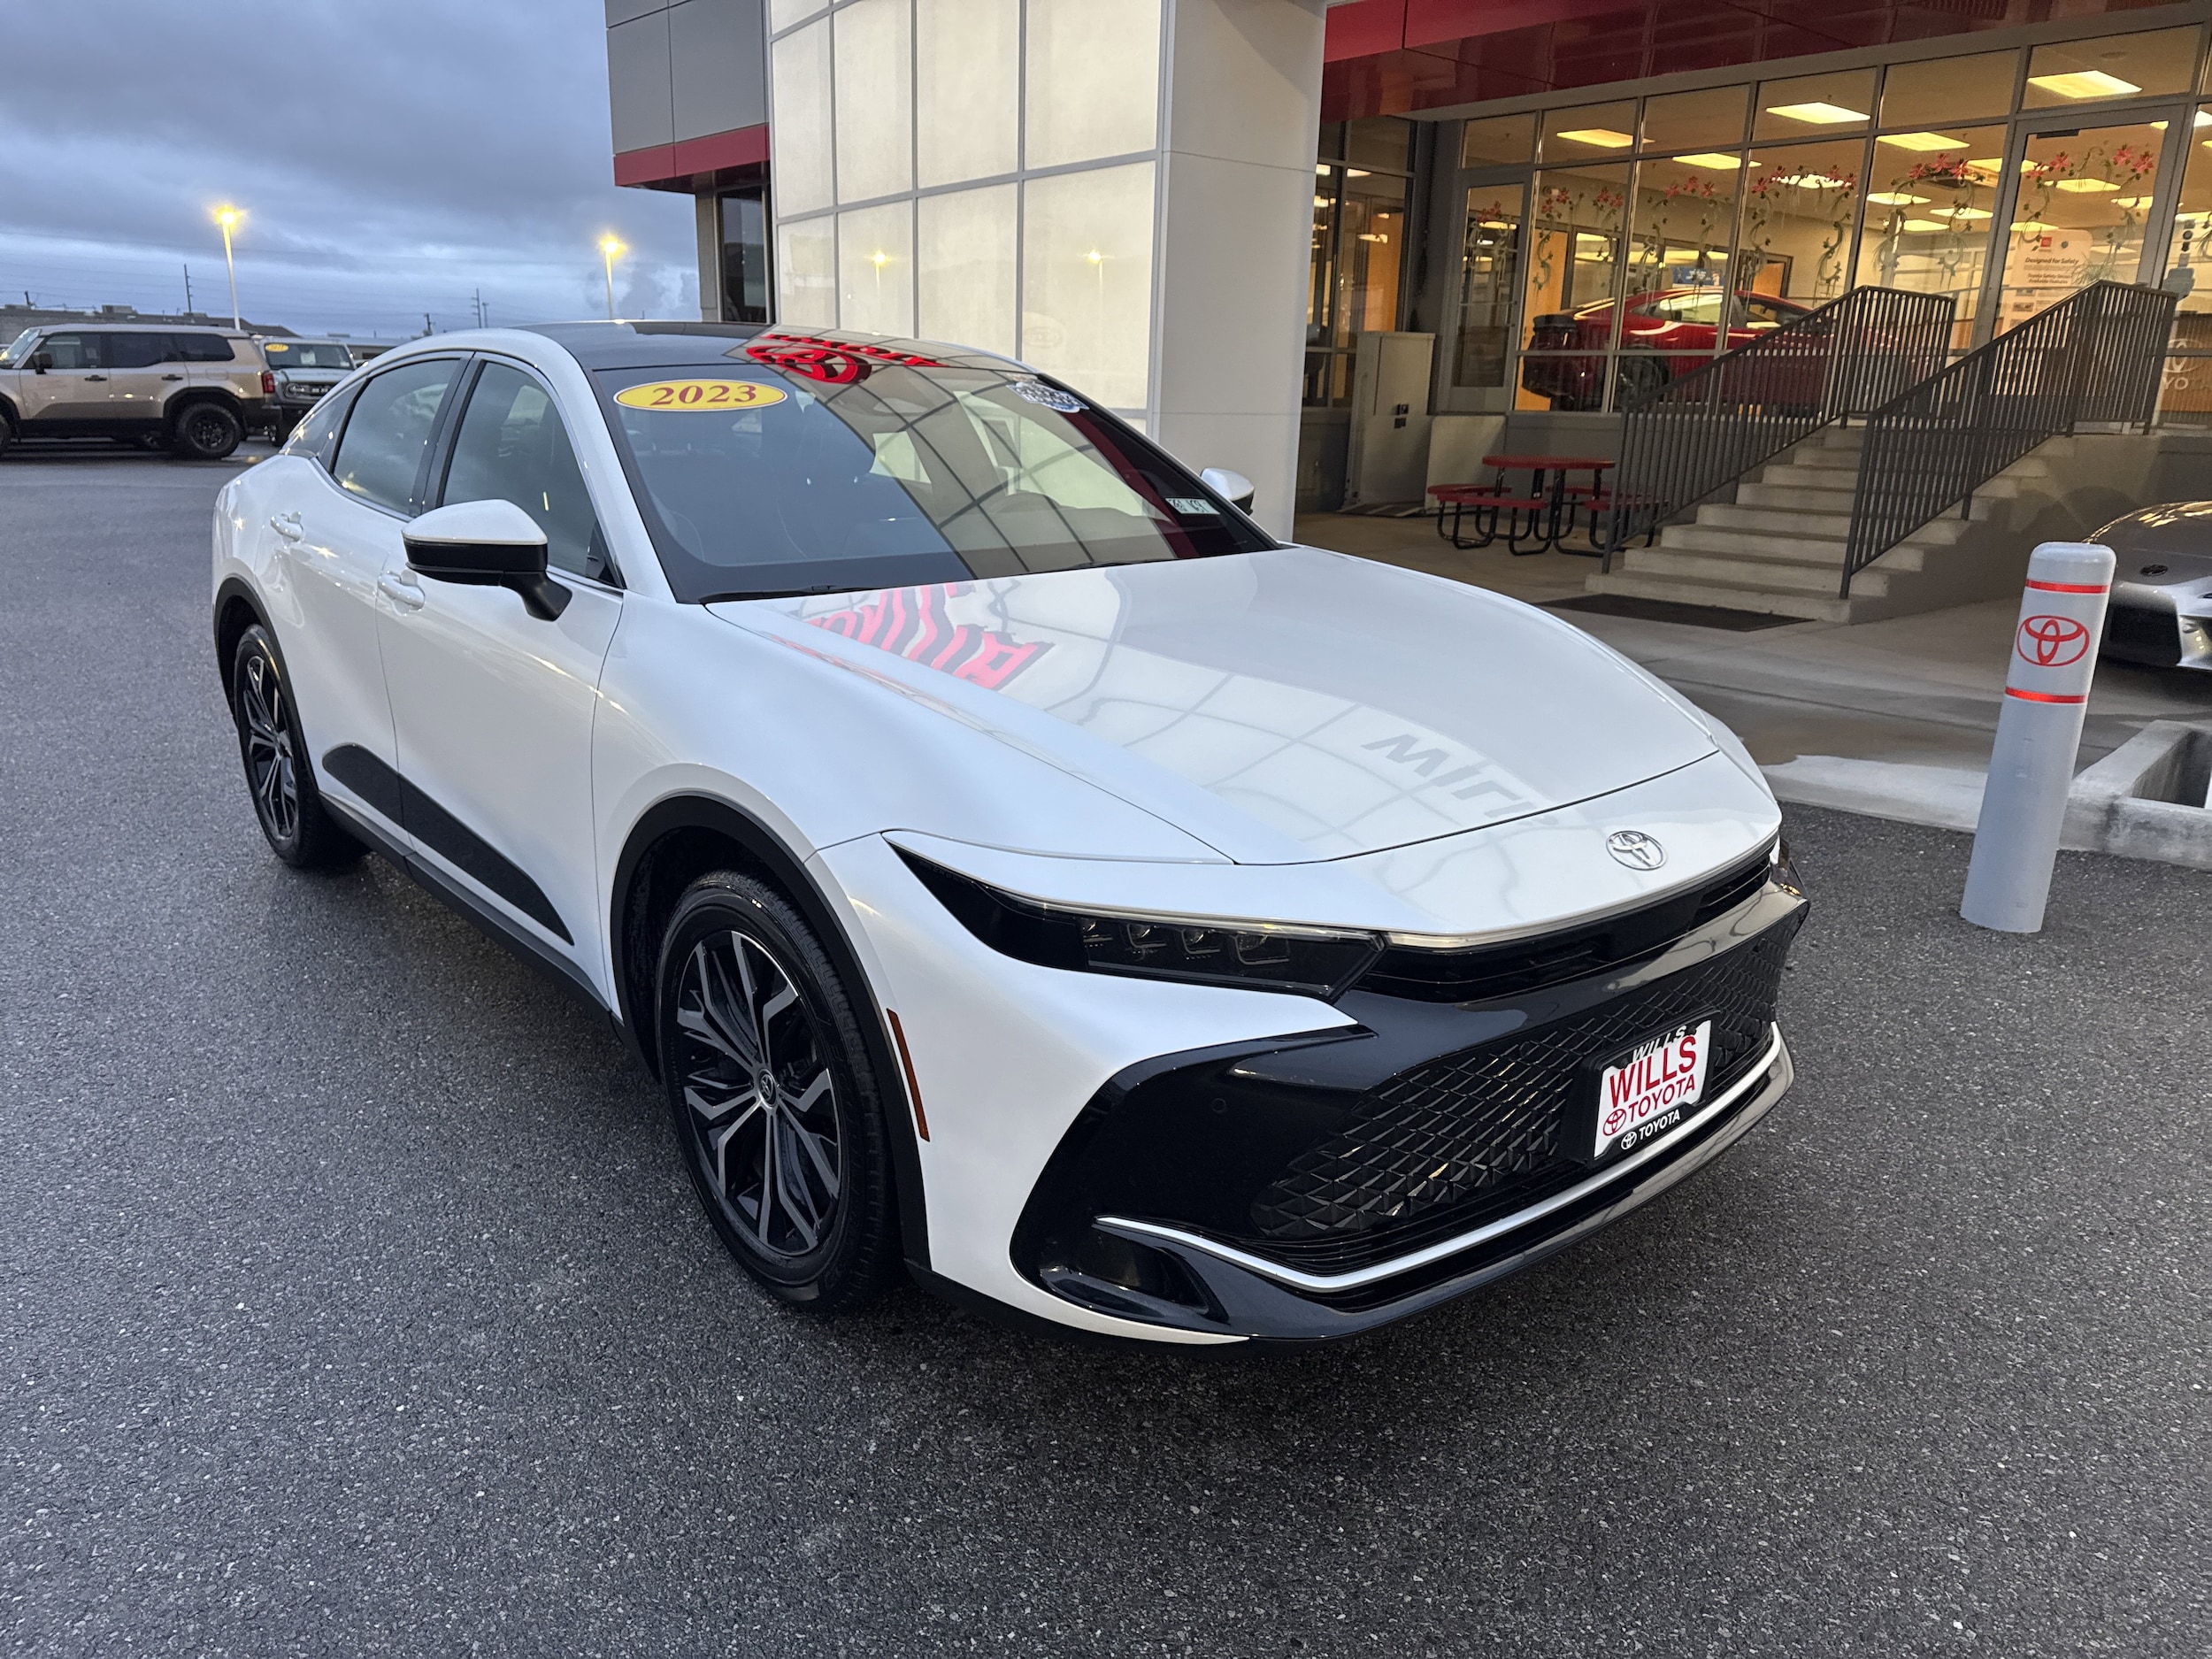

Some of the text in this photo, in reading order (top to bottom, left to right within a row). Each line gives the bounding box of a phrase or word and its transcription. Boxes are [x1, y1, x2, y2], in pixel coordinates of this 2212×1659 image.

[649, 385, 757, 406] 2023
[1632, 1025, 1687, 1063] WILLS
[1609, 1036, 1696, 1108] WILLS
[1629, 1074, 1695, 1122] TOYOTA
[1639, 1110, 1680, 1140] TOYOTA
